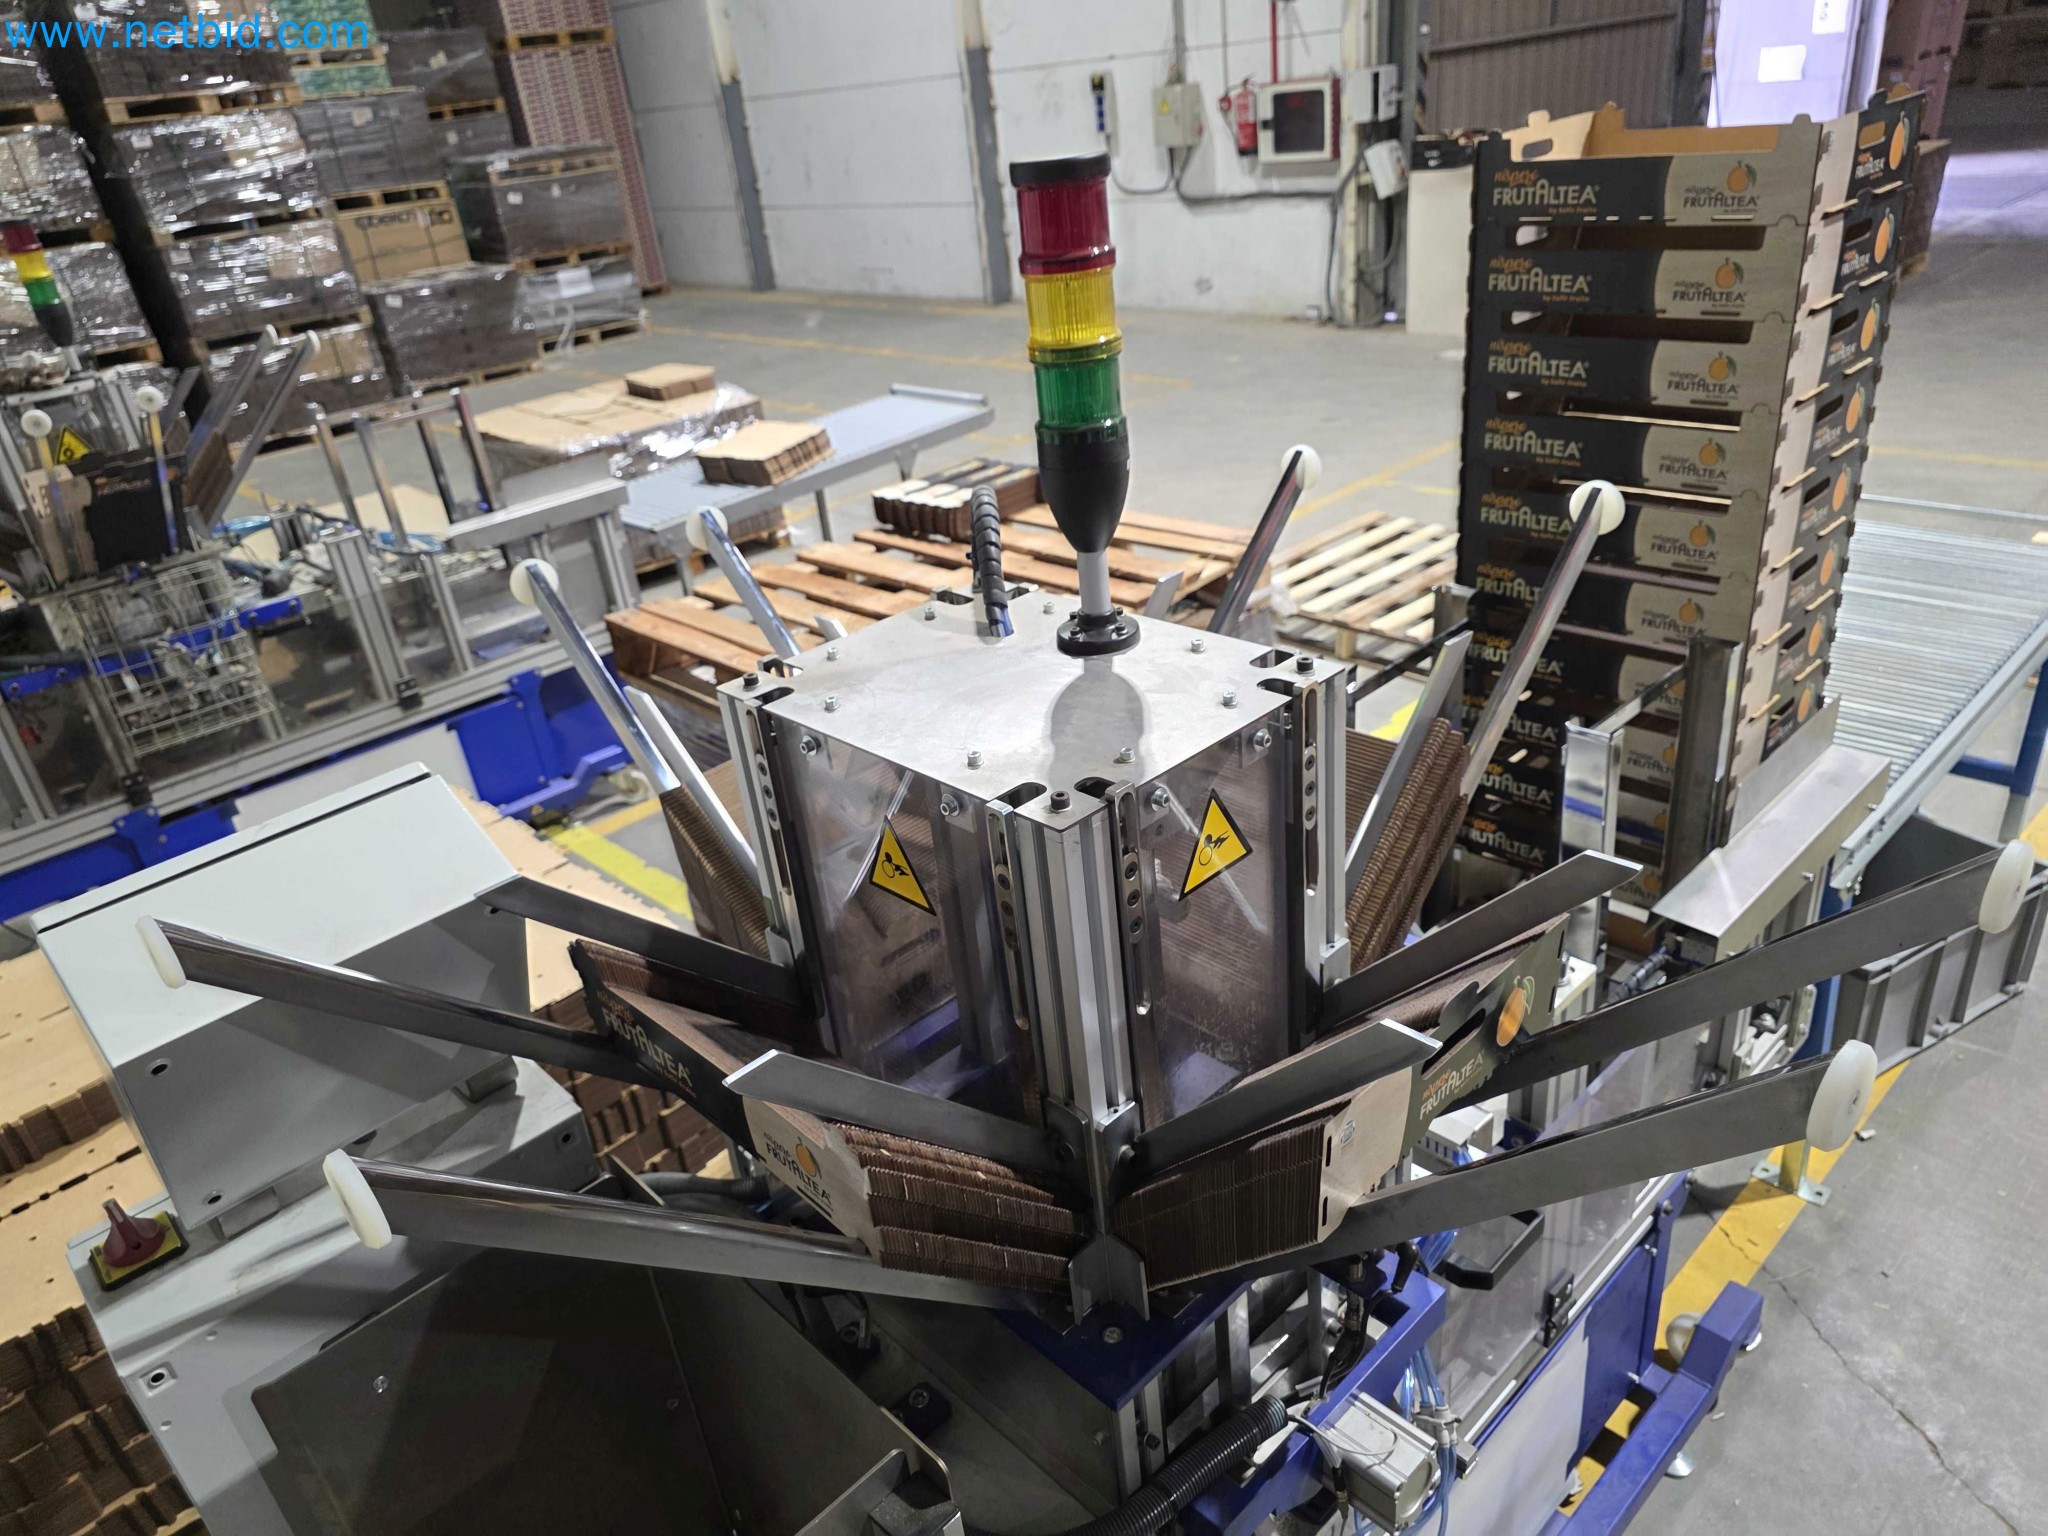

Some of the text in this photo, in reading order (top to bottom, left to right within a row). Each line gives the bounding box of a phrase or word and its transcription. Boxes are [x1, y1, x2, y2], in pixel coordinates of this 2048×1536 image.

[602, 1007, 693, 1088] FRUTALTEA
[1420, 1052, 1483, 1121] FRUTALTEA
[766, 1142, 832, 1206] FRUTALTEA
